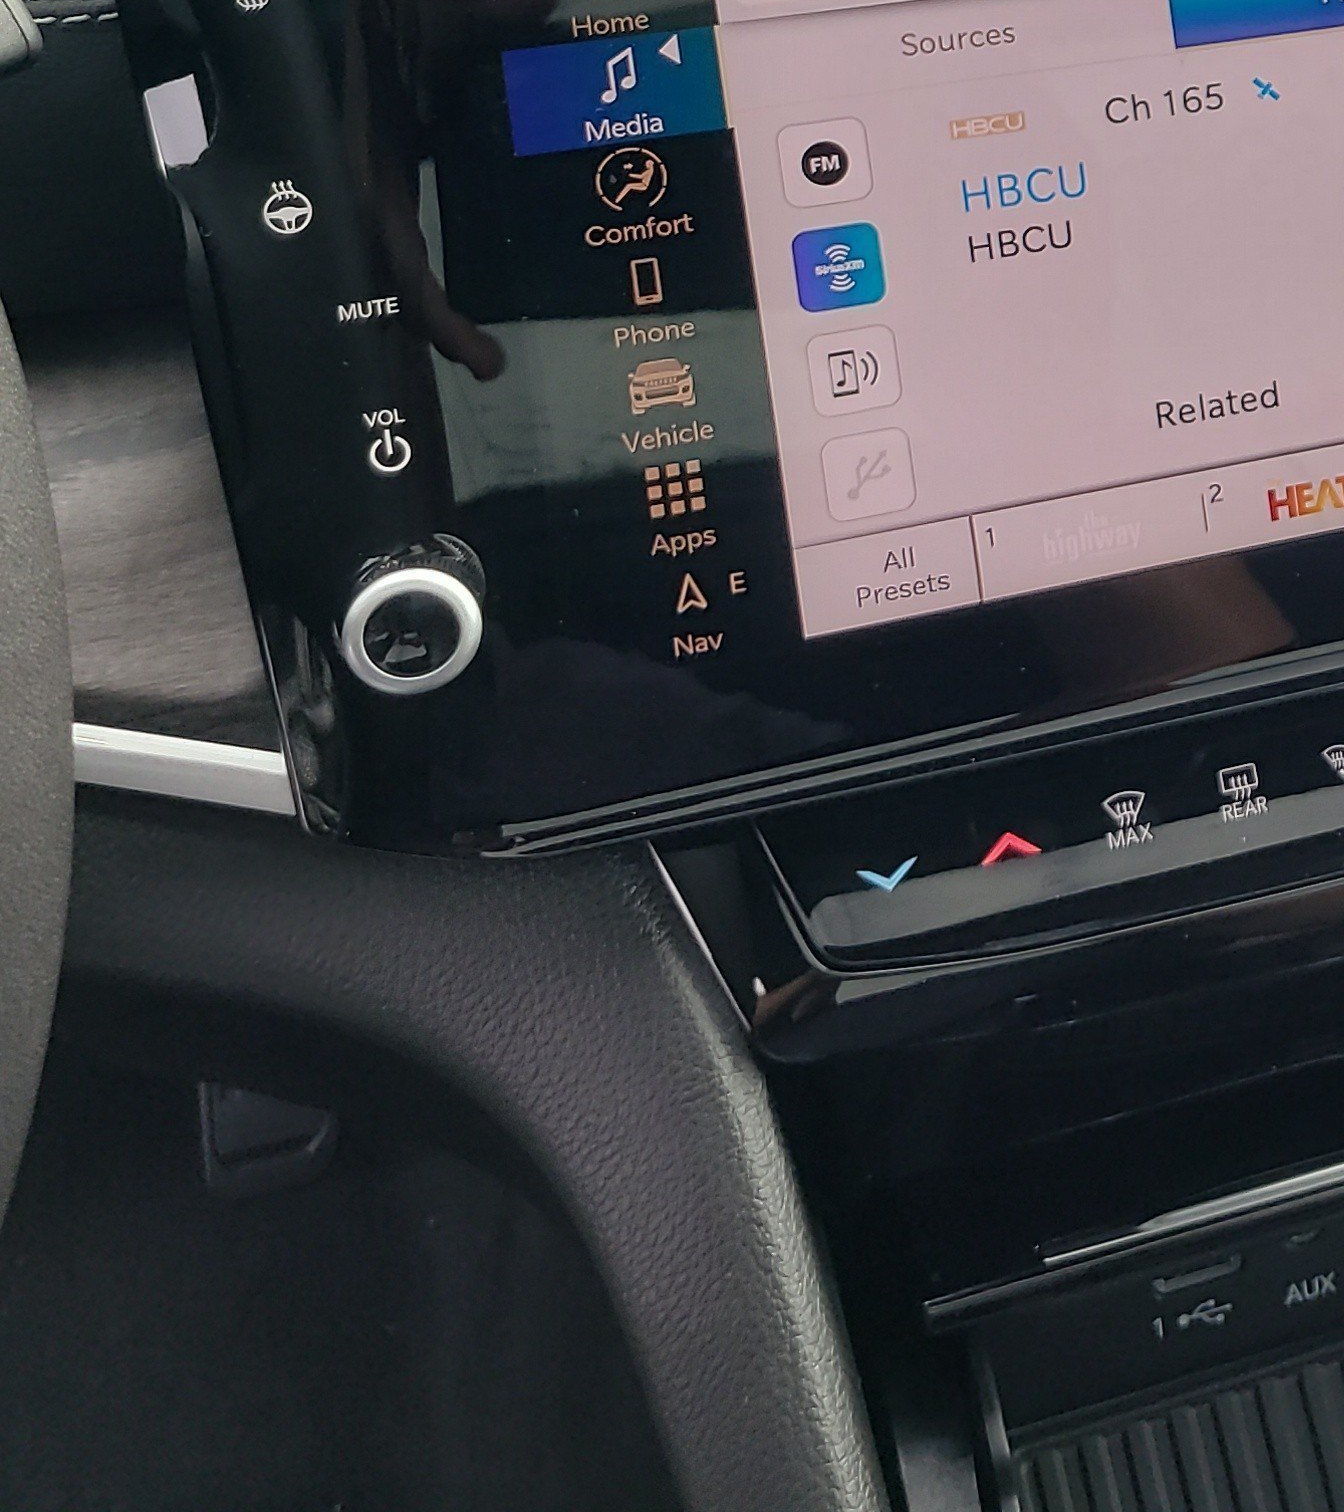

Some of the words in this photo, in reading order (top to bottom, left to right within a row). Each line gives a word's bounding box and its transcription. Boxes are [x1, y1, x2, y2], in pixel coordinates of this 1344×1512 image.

[570, 10, 649, 37] Home
[900, 23, 1017, 56] Sources
[1105, 92, 1152, 124] Ch
[1164, 82, 1226, 118] 165
[584, 113, 664, 143] Media
[953, 112, 1022, 138] HBCU
[809, 154, 841, 174] FM
[960, 161, 1090, 214] HBCU
[584, 213, 694, 247] Comfort
[967, 220, 1074, 264] HBCU
[336, 296, 401, 323] MUTE
[613, 318, 696, 350] Phone
[363, 408, 406, 429] VOL
[1155, 381, 1282, 430] Related
[621, 421, 715, 455] Vehicle
[1209, 484, 1224, 504] 2
[650, 526, 717, 558] Apps
[985, 527, 996, 548] 1
[882, 546, 915, 571] All
[729, 571, 747, 596] E
[855, 570, 952, 610] Presets
[672, 630, 724, 658] Nav
[1220, 795, 1269, 823] REAR
[1106, 822, 1155, 851] MAX
[1284, 1270, 1337, 1307] AUX
[1152, 1316, 1165, 1339] 1
